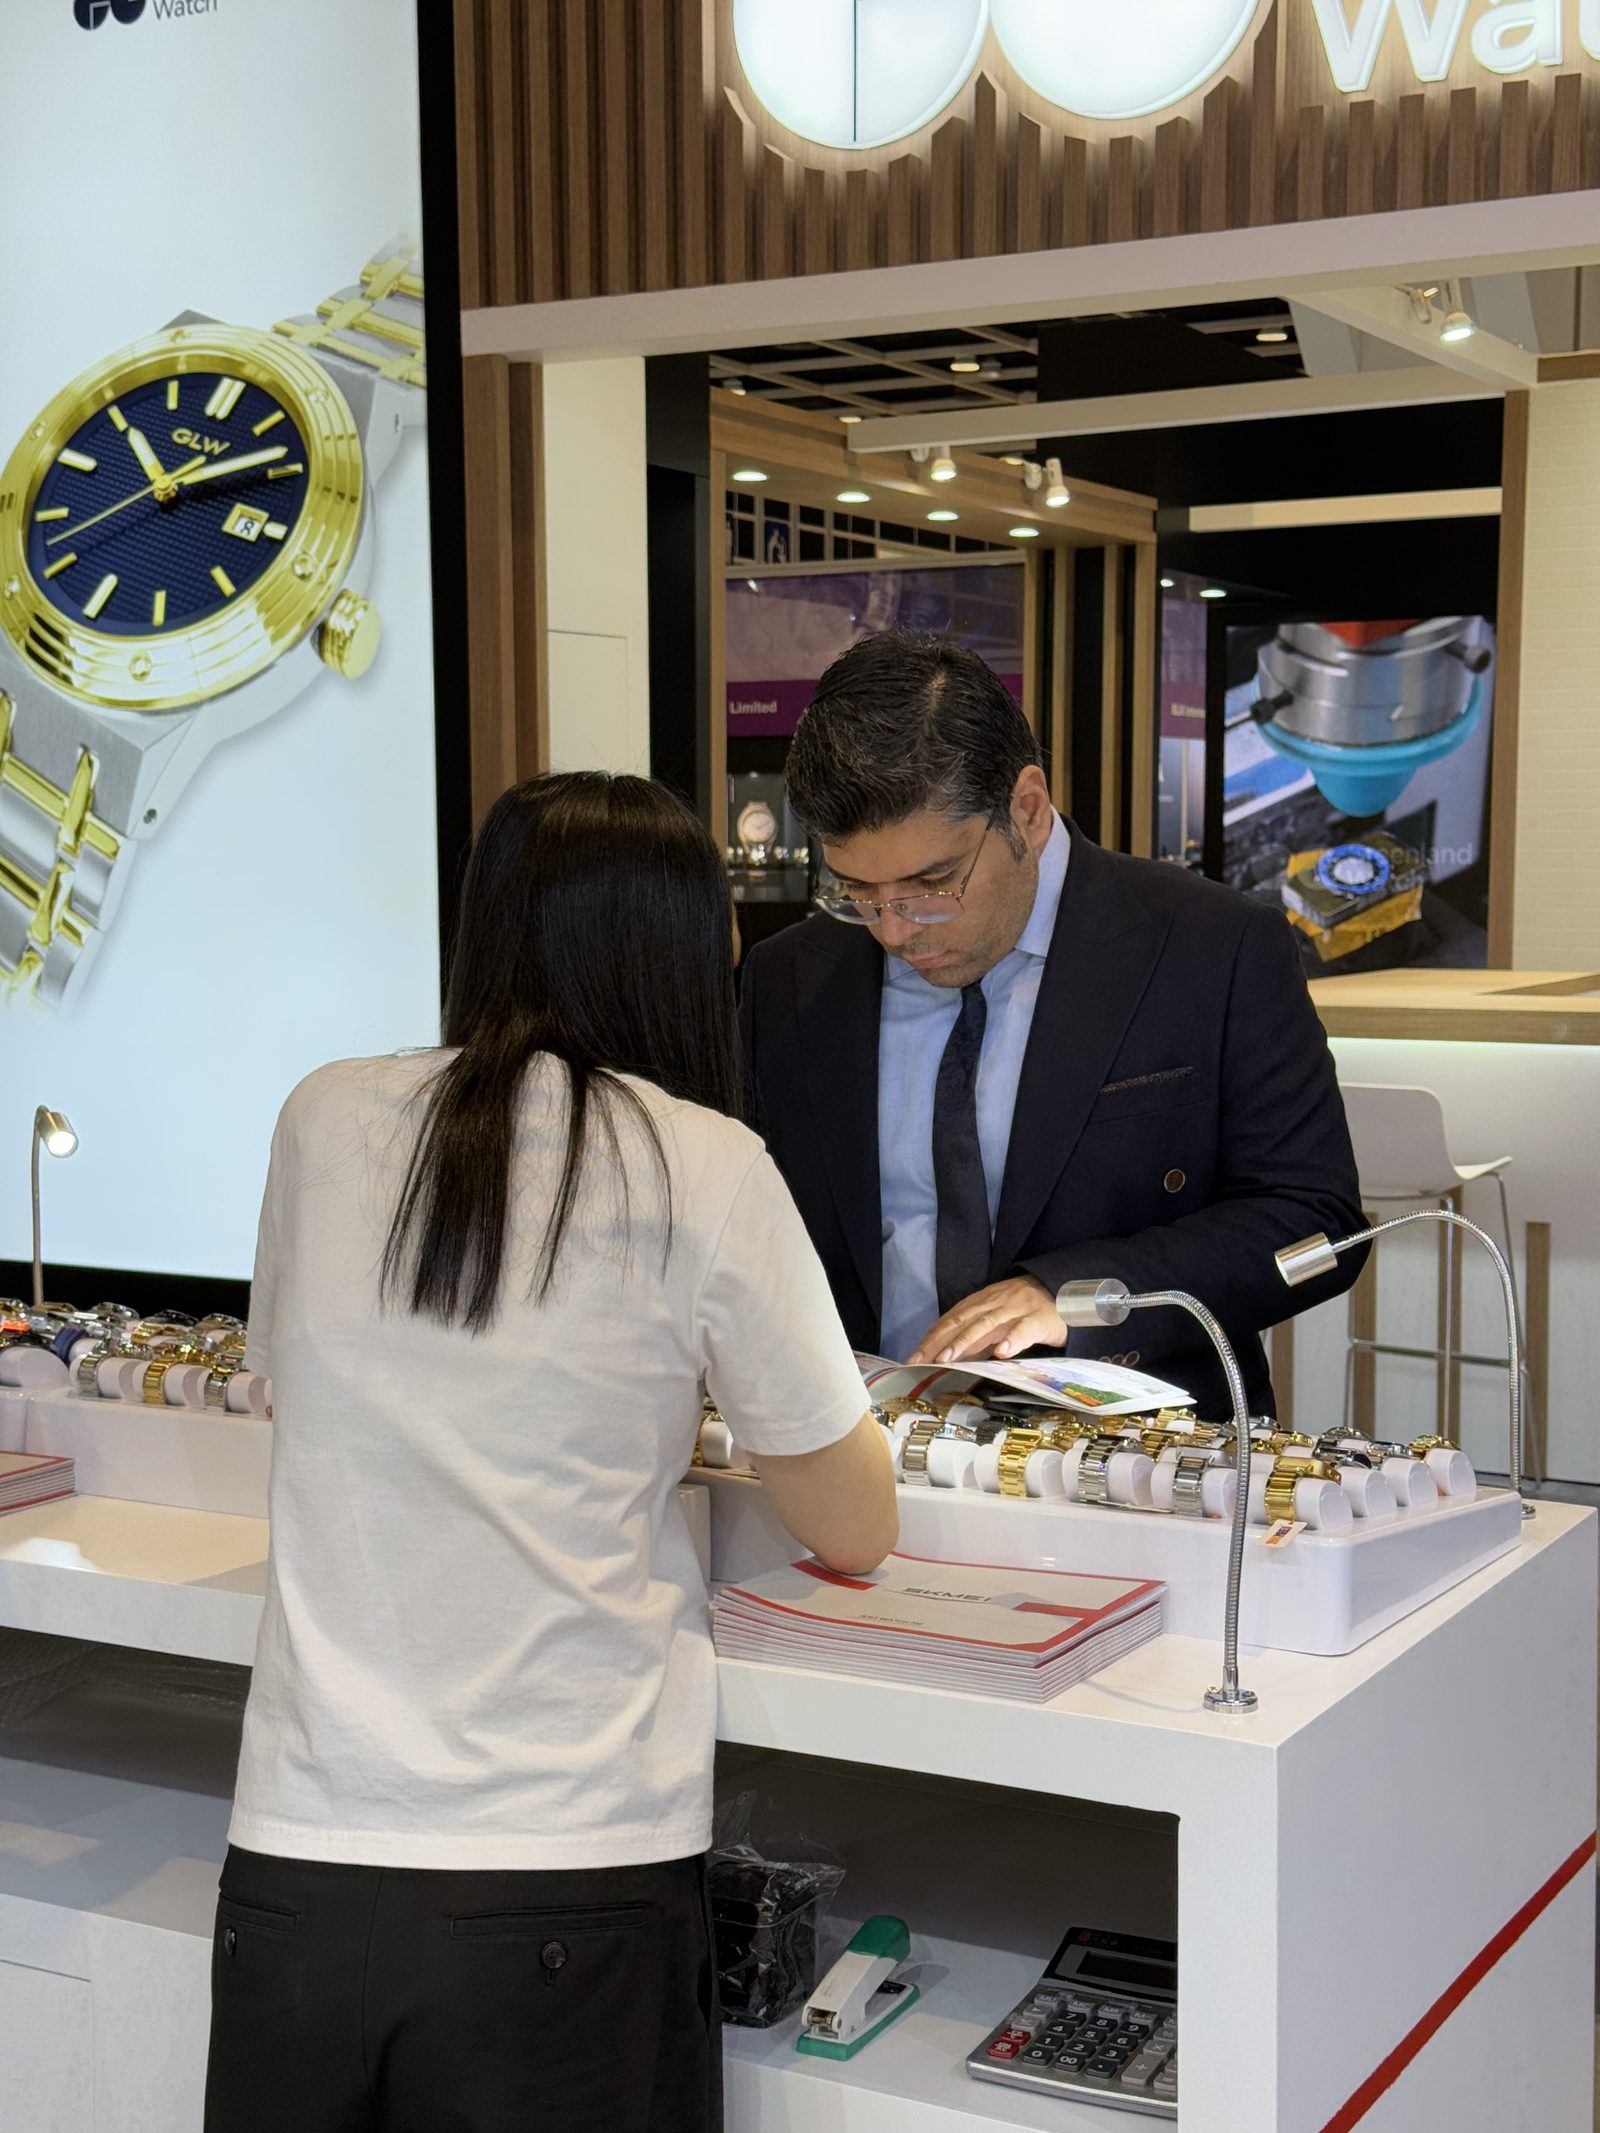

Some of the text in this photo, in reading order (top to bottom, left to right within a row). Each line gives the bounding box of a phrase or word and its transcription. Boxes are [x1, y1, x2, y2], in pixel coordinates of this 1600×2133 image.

[1312, 0, 1600, 93] Wa
[171, 427, 231, 456] GLW
[729, 700, 778, 714] Limited
[902, 1587, 992, 1602] SKMEI
[1085, 2030, 1097, 2038] 5
[1073, 2043, 1085, 2051] 2
[1031, 2050, 1078, 2064] 0 00
